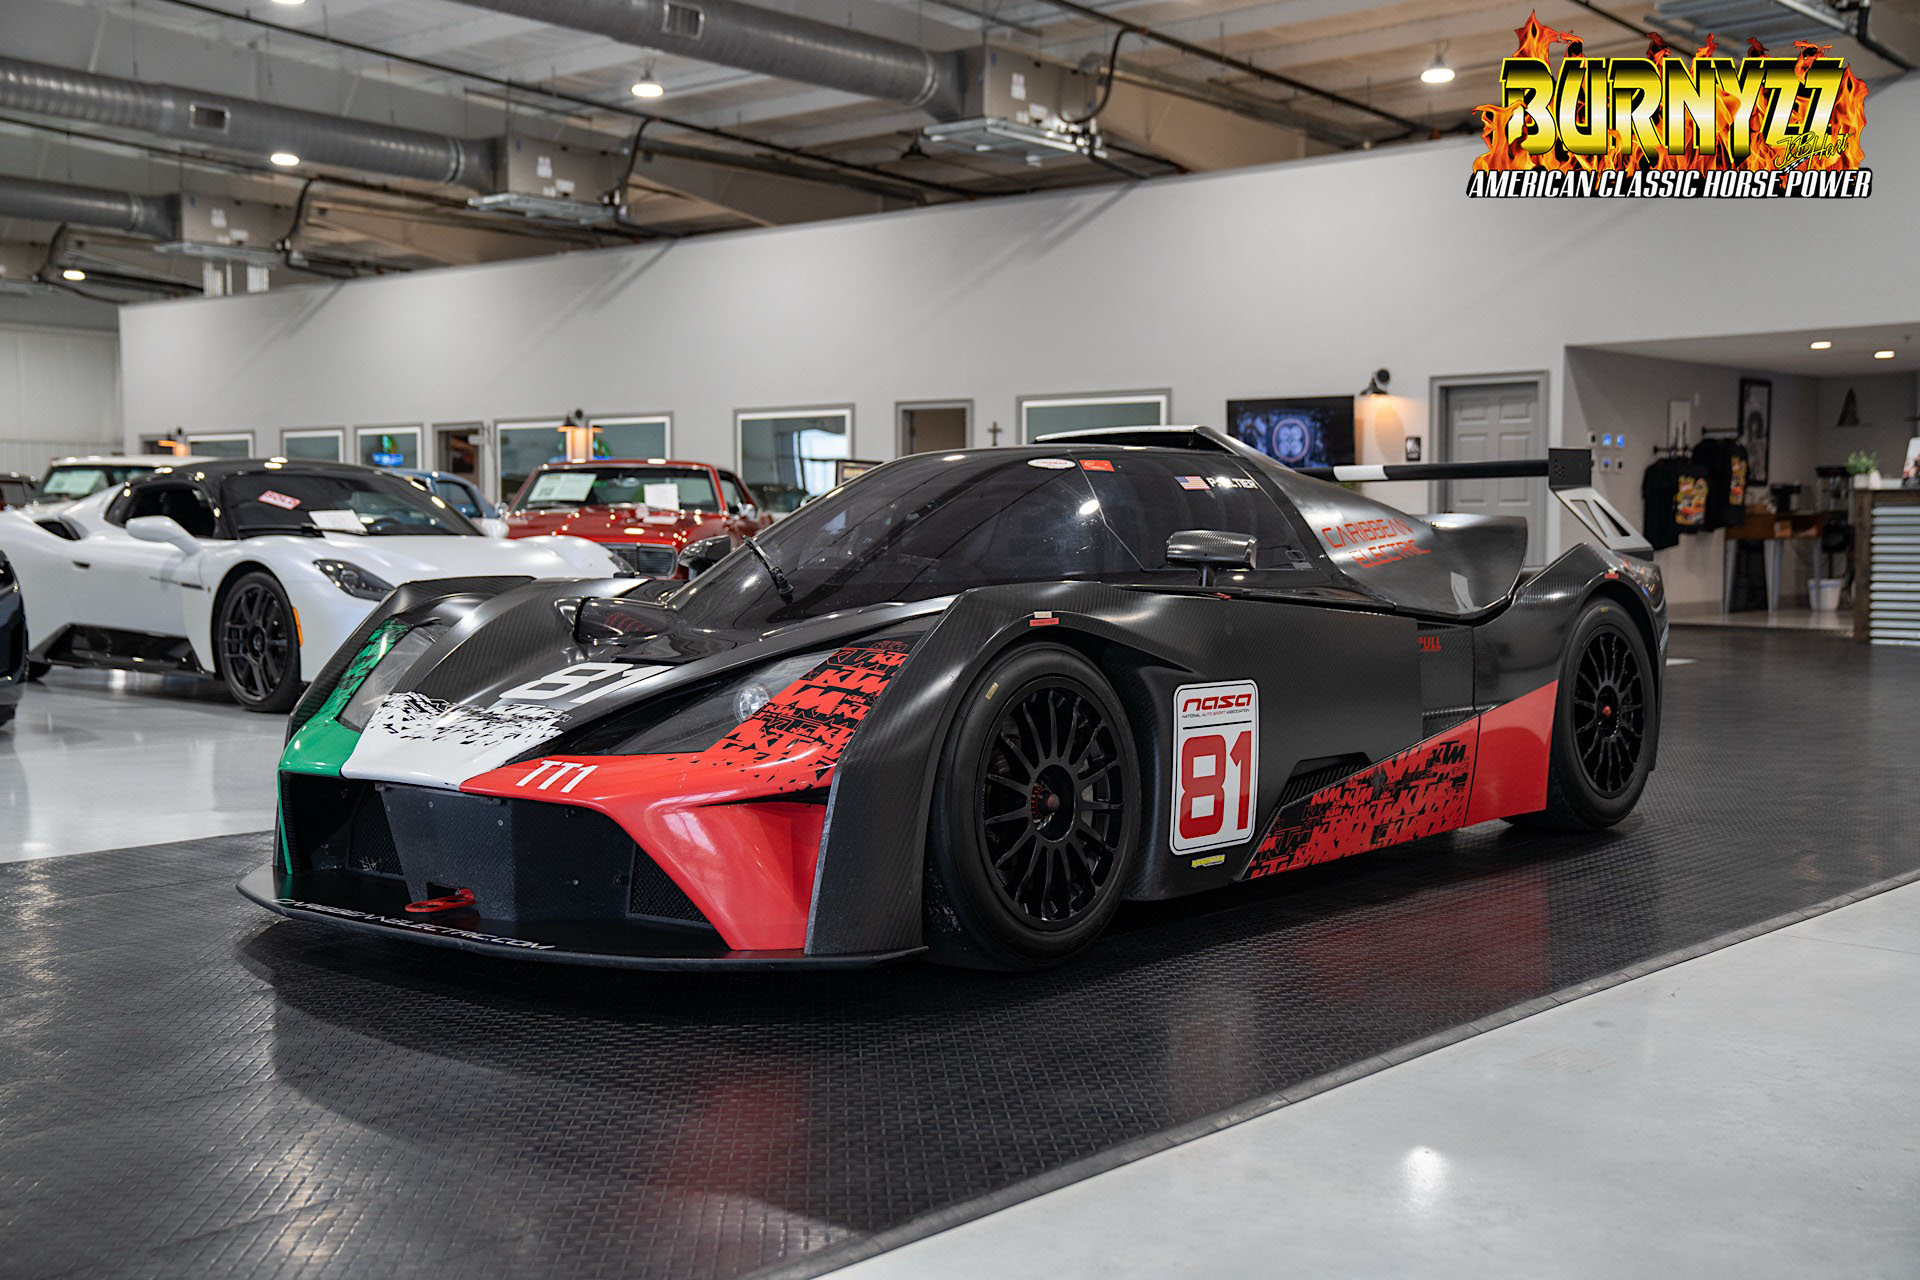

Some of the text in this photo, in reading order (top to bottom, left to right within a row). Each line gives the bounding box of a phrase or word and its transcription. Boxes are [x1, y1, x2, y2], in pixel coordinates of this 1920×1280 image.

[1322, 518, 1415, 549] CARIBBEAN
[499, 662, 675, 704] 81
[1183, 693, 1252, 712] nasa
[1432, 740, 1466, 765] KTM
[515, 759, 599, 794] TT1
[1179, 731, 1252, 839] 81
